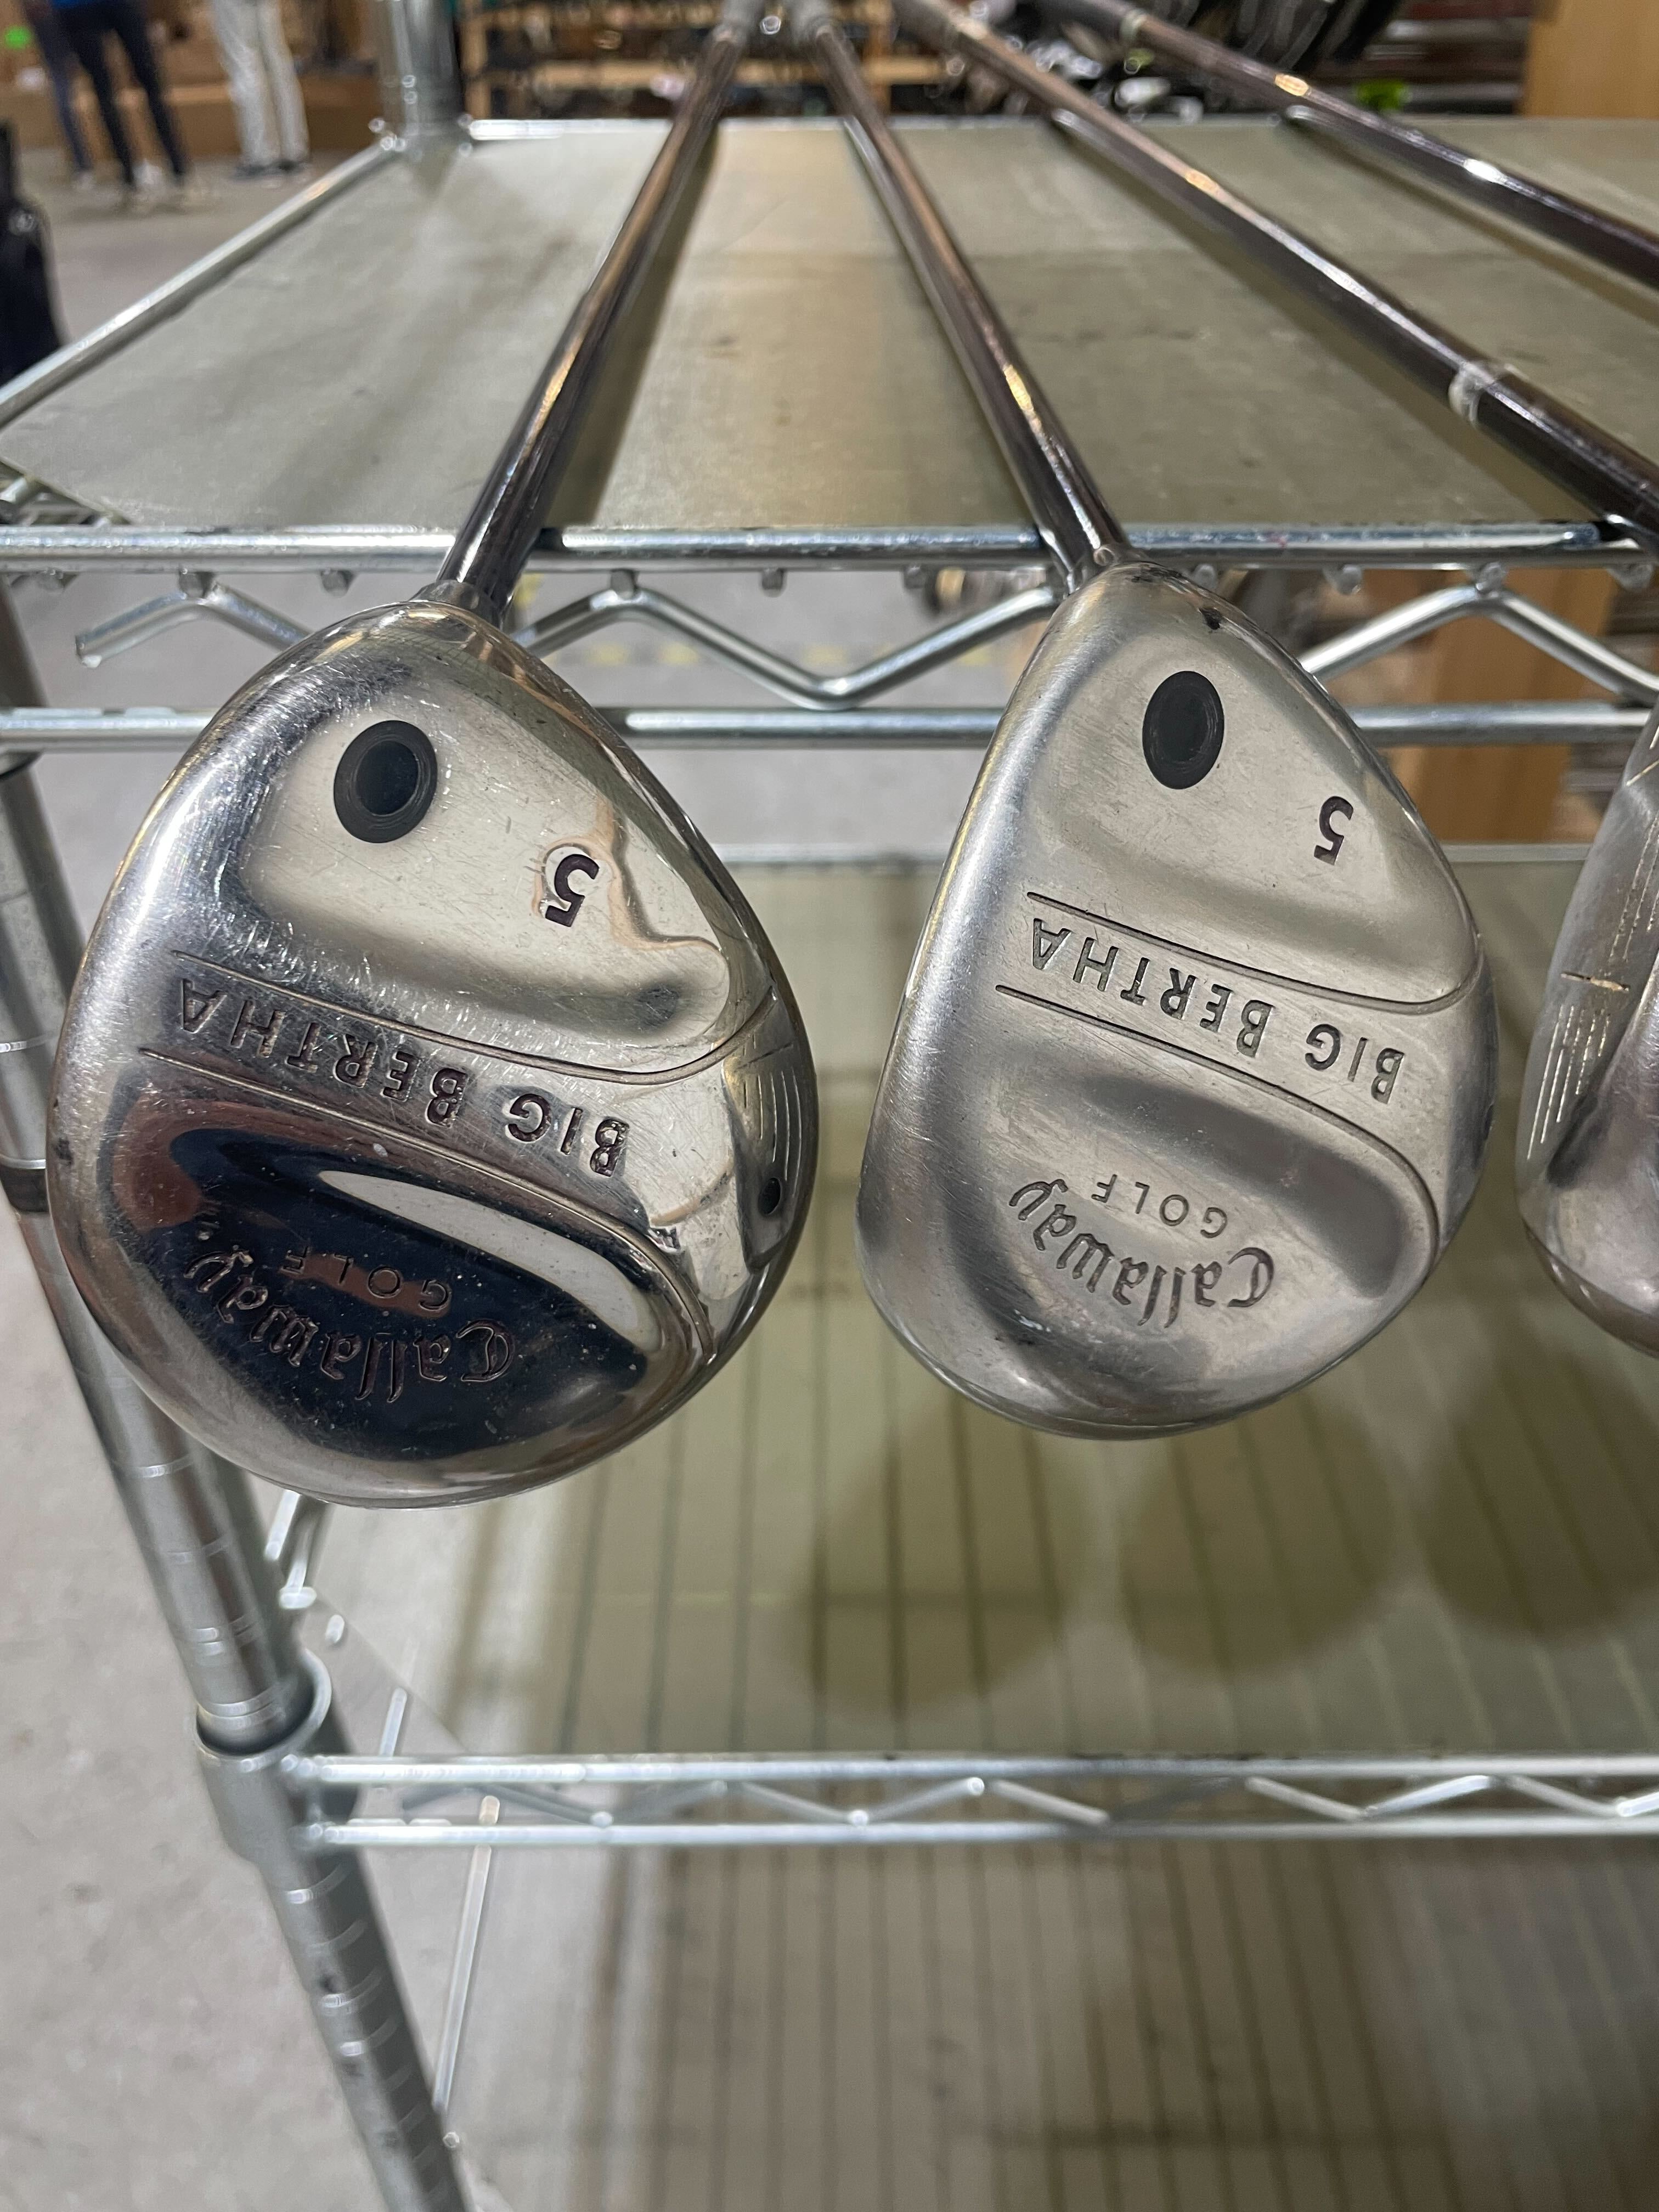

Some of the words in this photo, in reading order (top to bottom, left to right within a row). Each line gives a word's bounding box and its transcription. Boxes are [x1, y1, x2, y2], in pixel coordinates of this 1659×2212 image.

[1313, 796, 1354, 865] 5
[545, 853, 599, 927] 5
[1032, 918, 1274, 1058] BERTHA
[179, 979, 467, 1127] BERTHA
[1305, 1024, 1405, 1104] BIG
[507, 1093, 630, 1177] BIG
[1091, 1174, 1227, 1238] GOLF
[280, 1246, 450, 1312] GOLF
[1009, 1179, 1274, 1328] Callaway
[183, 1249, 515, 1403] Callaway
